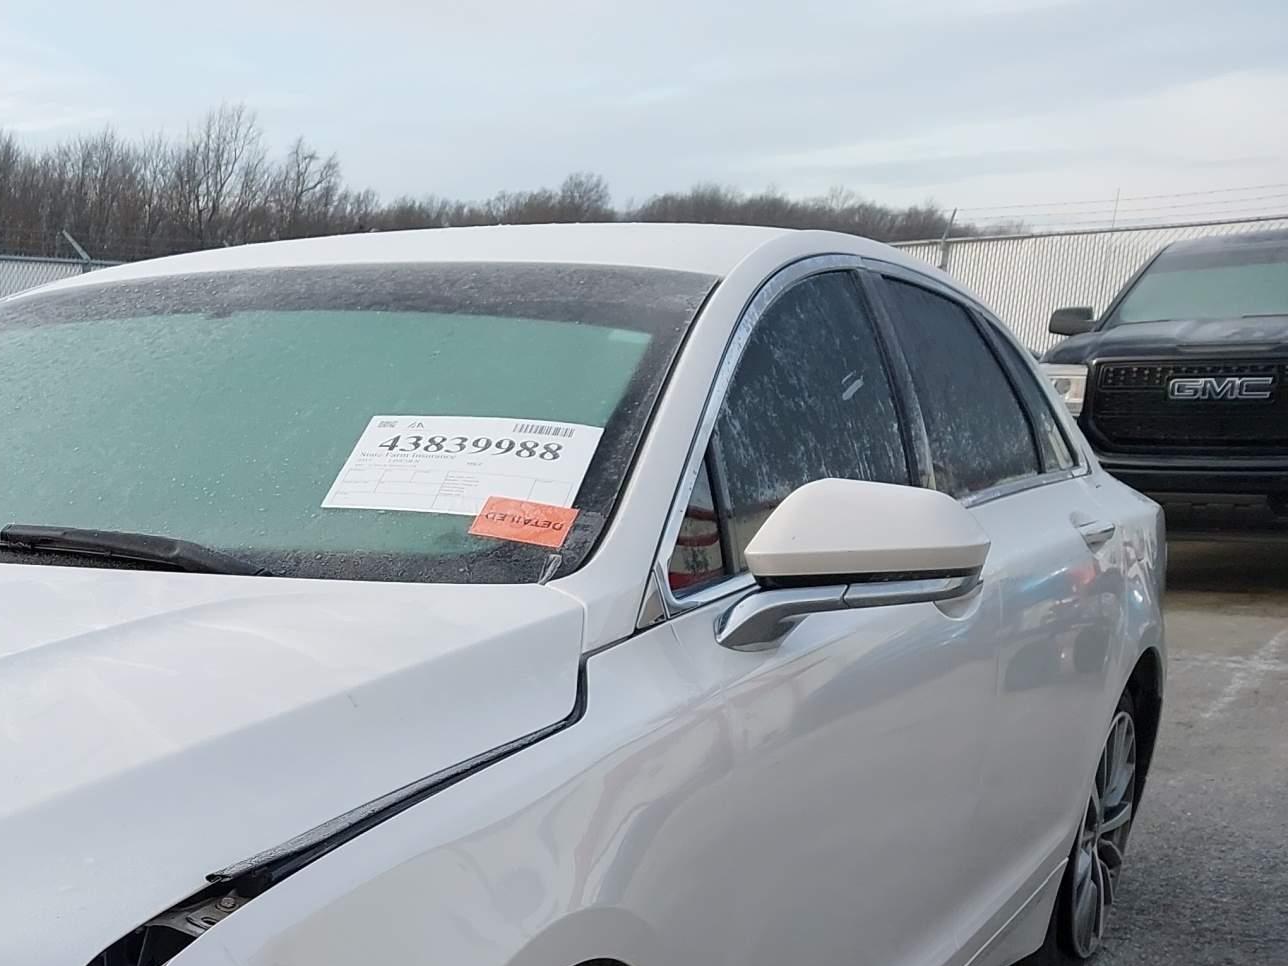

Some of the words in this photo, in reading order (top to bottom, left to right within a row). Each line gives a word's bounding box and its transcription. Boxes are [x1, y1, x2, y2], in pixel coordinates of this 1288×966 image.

[1169, 377, 1273, 399] GMC
[378, 435, 563, 461] 43839988
[485, 511, 564, 532] DETAILED
